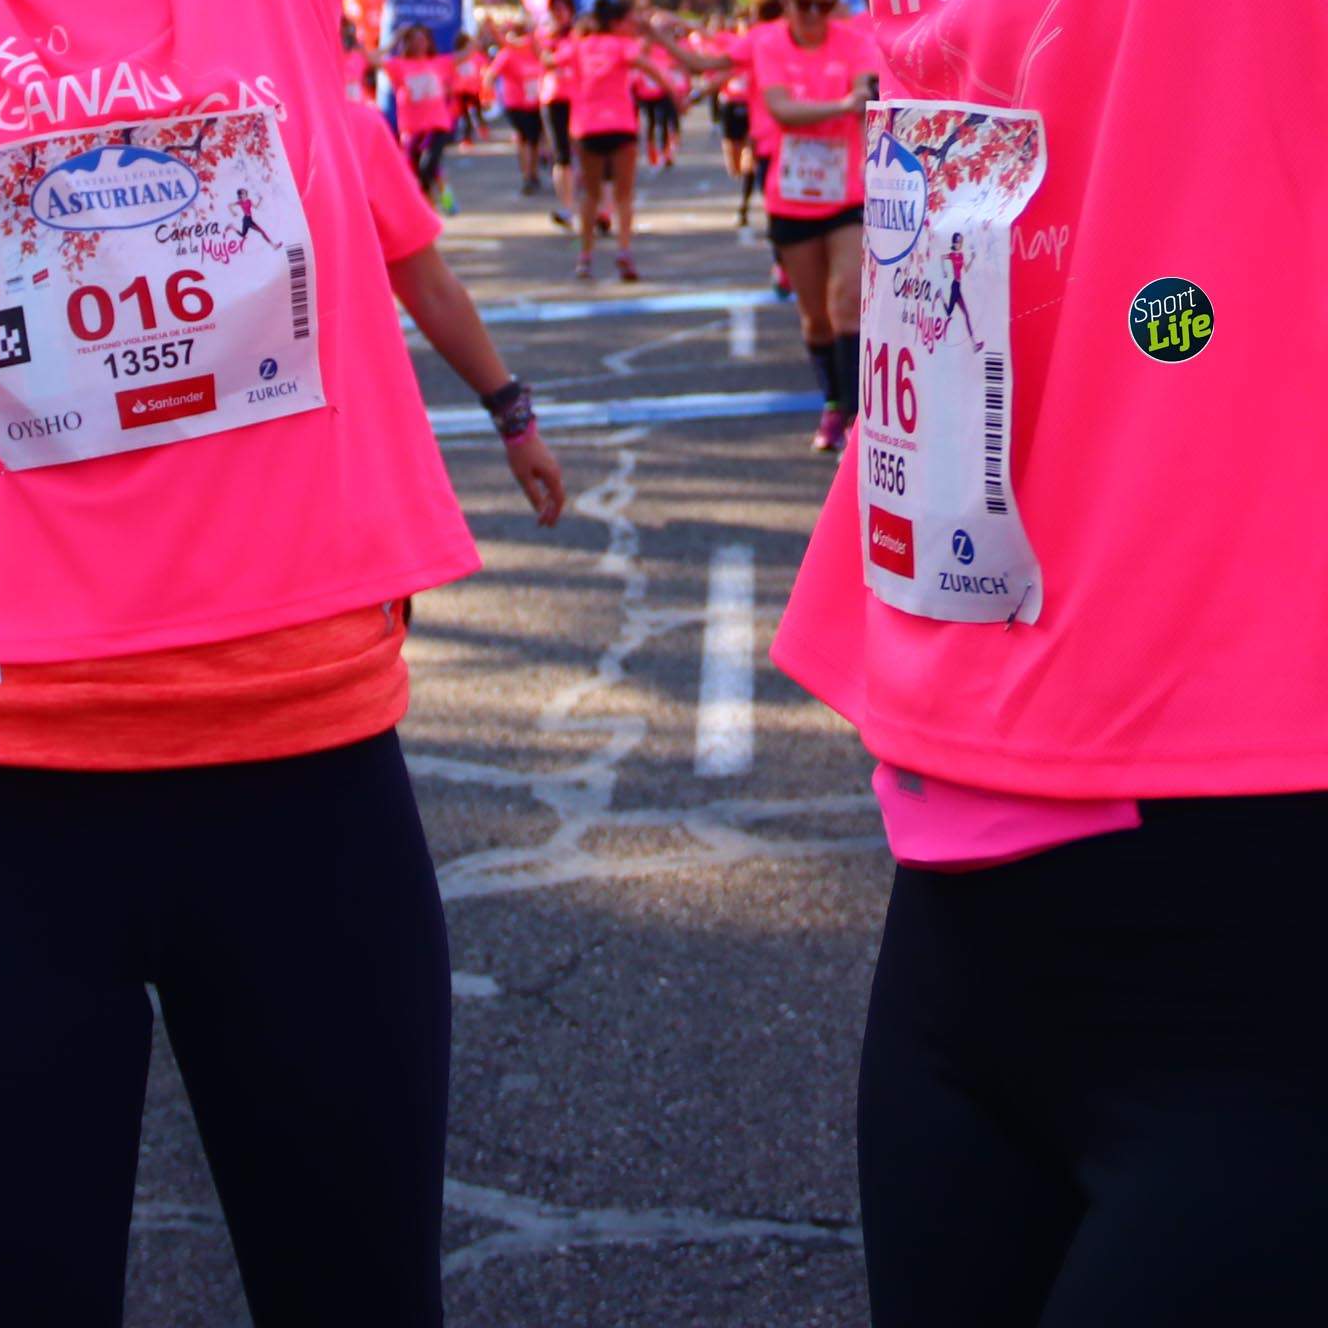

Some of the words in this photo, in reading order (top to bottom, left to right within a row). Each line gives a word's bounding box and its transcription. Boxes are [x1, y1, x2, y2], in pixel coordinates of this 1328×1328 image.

[46, 179, 189, 220] ASTURIANA
[154, 221, 221, 245] Carrera
[175, 242, 188, 257] de
[190, 240, 199, 255] la
[200, 235, 247, 265] Mujer
[893, 267, 933, 302] Carrera
[66, 269, 214, 342] 016
[1134, 286, 1197, 323] Sport
[915, 304, 953, 354] Mujer
[1147, 309, 1212, 352] Life
[103, 339, 194, 379] 13557
[147, 390, 205, 412] Santander
[247, 382, 298, 404] ZURICH
[863, 338, 918, 434] 016
[8, 411, 82, 441] OYSHO
[867, 445, 906, 497] 13556
[878, 534, 907, 555] Santander
[938, 572, 1008, 595] ZURICH
